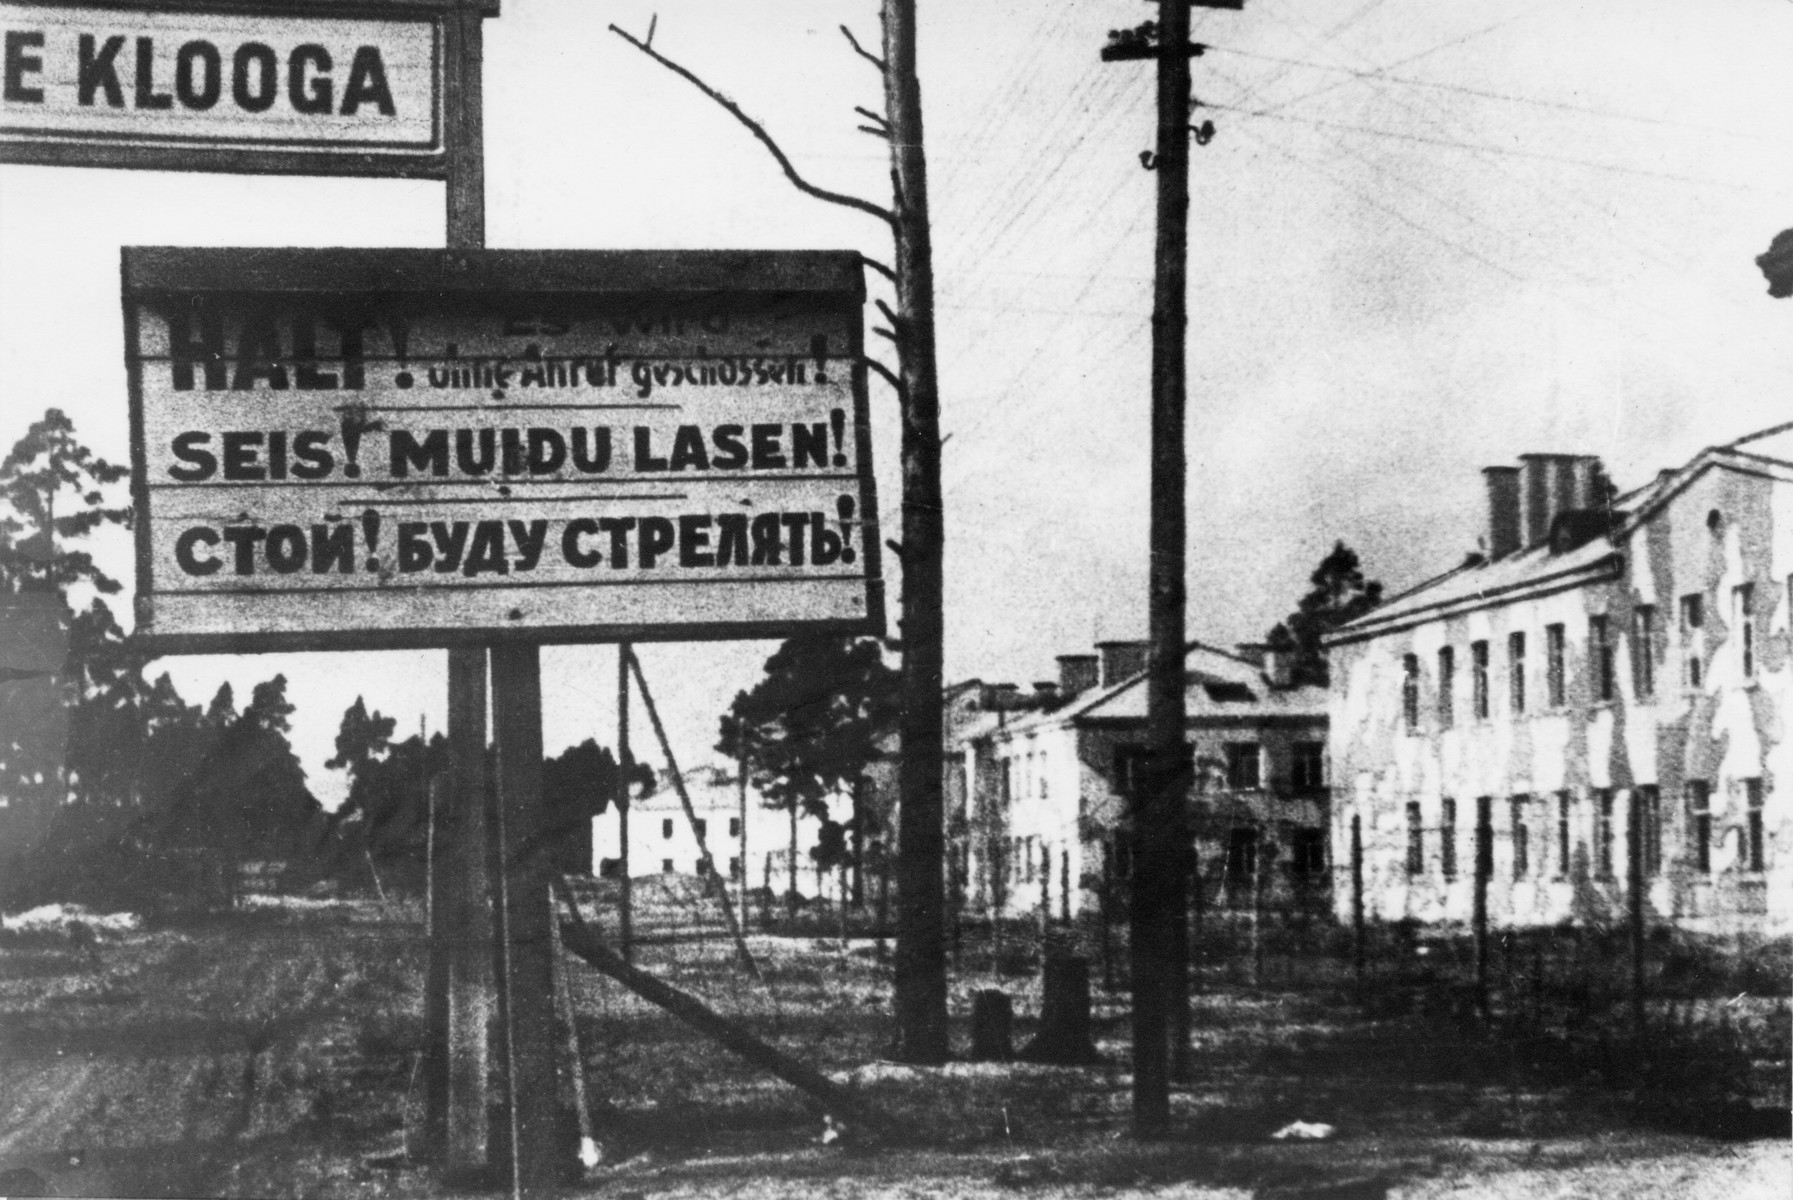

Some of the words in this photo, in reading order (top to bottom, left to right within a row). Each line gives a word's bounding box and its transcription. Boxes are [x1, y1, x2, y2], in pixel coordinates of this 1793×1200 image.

[77, 33, 398, 117] KLOOGA
[167, 306, 414, 390] HALT!
[168, 404, 362, 481] SEIS!
[390, 426, 611, 477] MUIDU
[633, 408, 846, 472] LASEN!
[174, 508, 380, 577] СТОЙ!
[397, 518, 548, 577] БУДУ
[561, 494, 856, 570] СТРЕЛЯТЬ!
